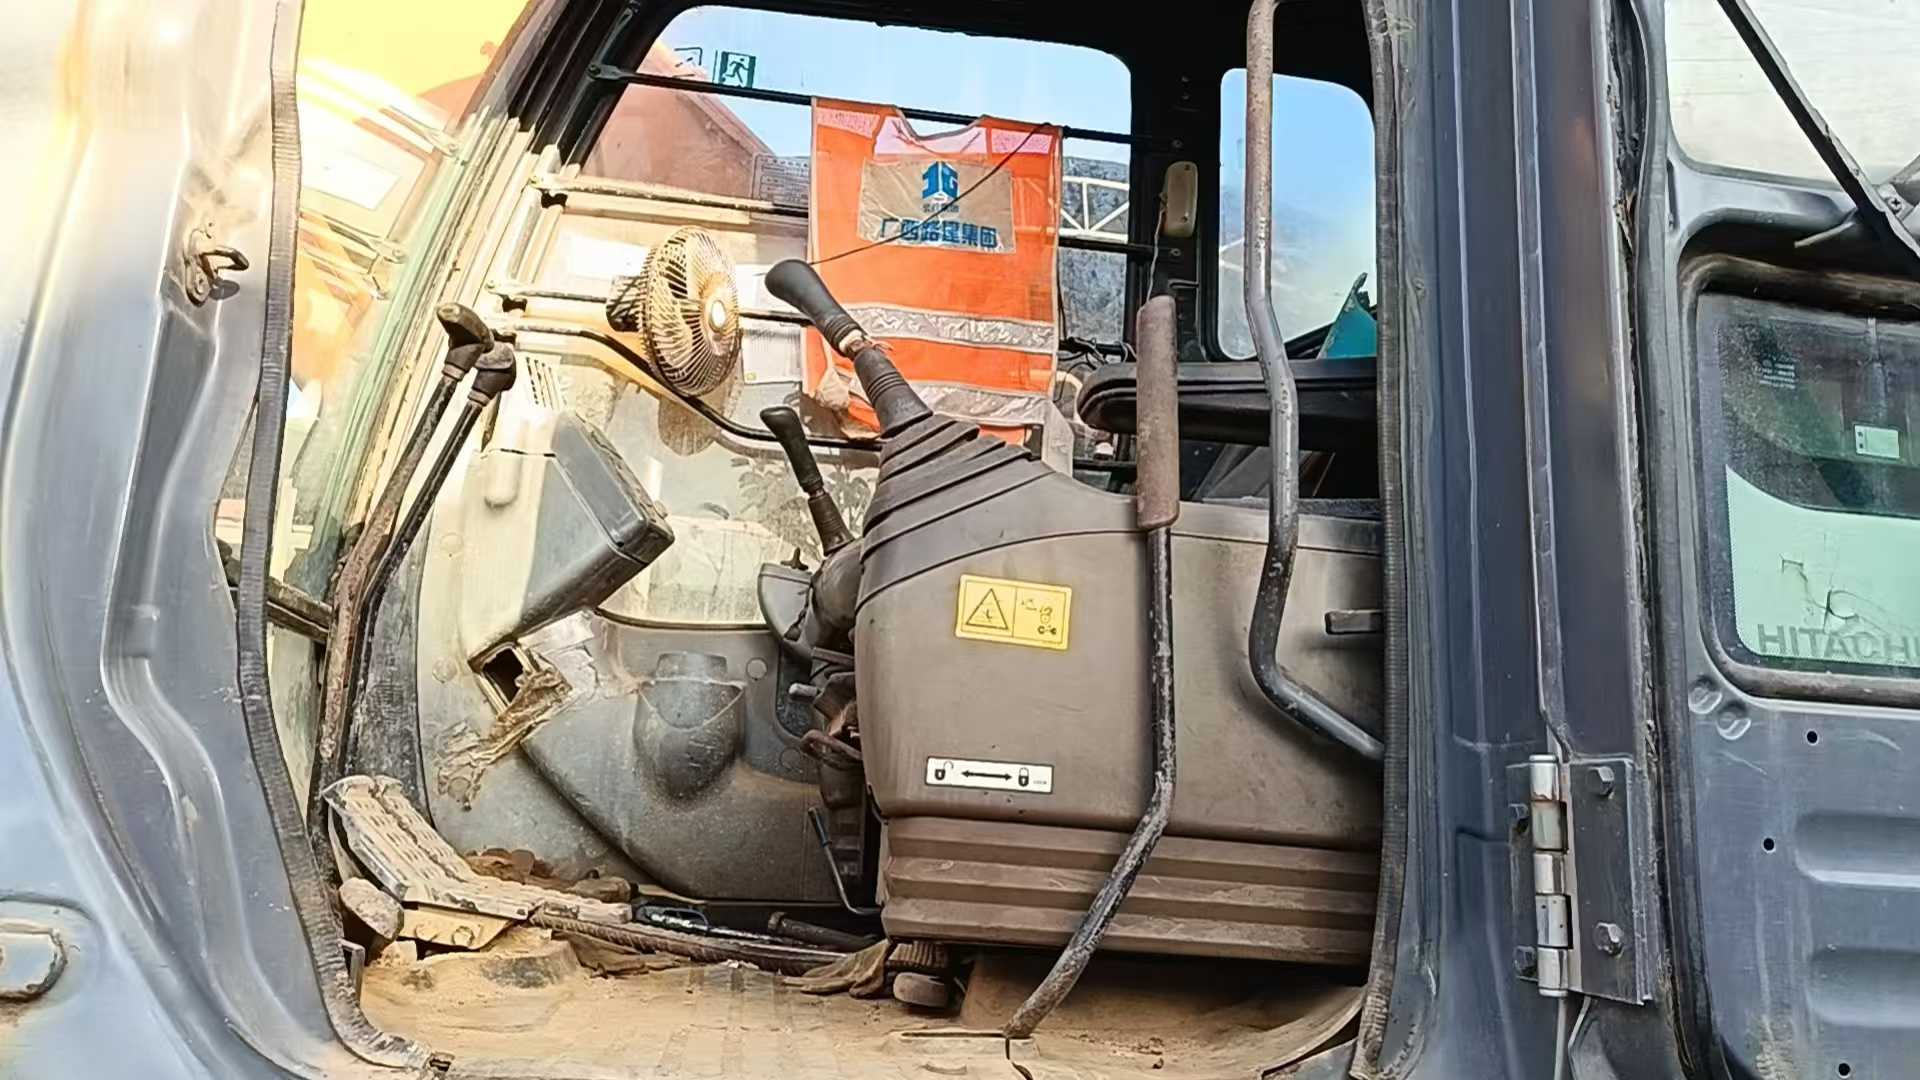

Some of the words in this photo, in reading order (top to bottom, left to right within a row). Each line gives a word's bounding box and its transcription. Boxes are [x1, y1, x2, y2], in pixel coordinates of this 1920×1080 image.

[880, 218, 998, 248] 广西路建集团
